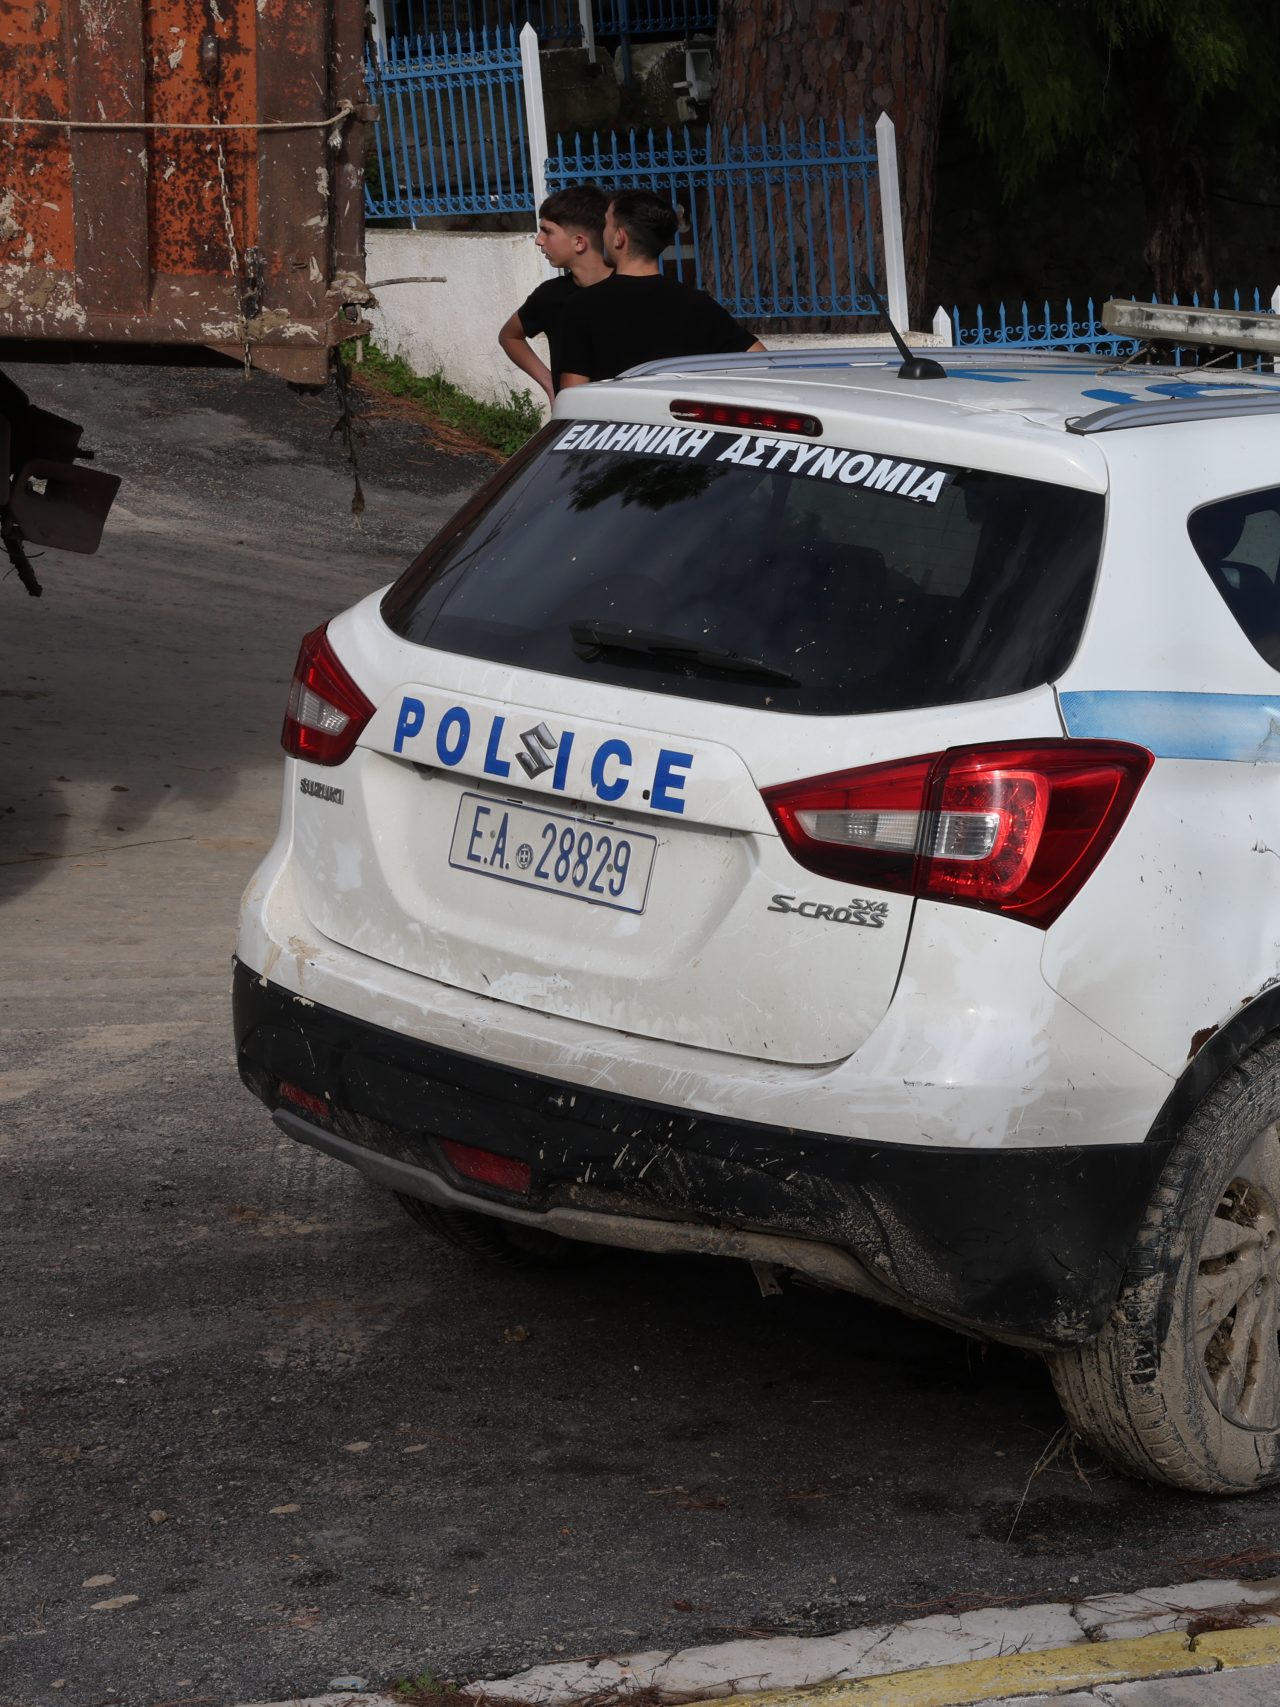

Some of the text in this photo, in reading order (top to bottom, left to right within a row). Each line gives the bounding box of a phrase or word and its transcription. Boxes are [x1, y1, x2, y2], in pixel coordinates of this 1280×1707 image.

[552, 424, 948, 503] ΕΛΛΗΝΙΚΗ ΑΣΤΥΝΟΜΙΑ
[300, 778, 345, 805] SUZUKI
[393, 696, 694, 814] POLICE
[534, 822, 632, 897] 28829
[849, 898, 889, 913] SX4
